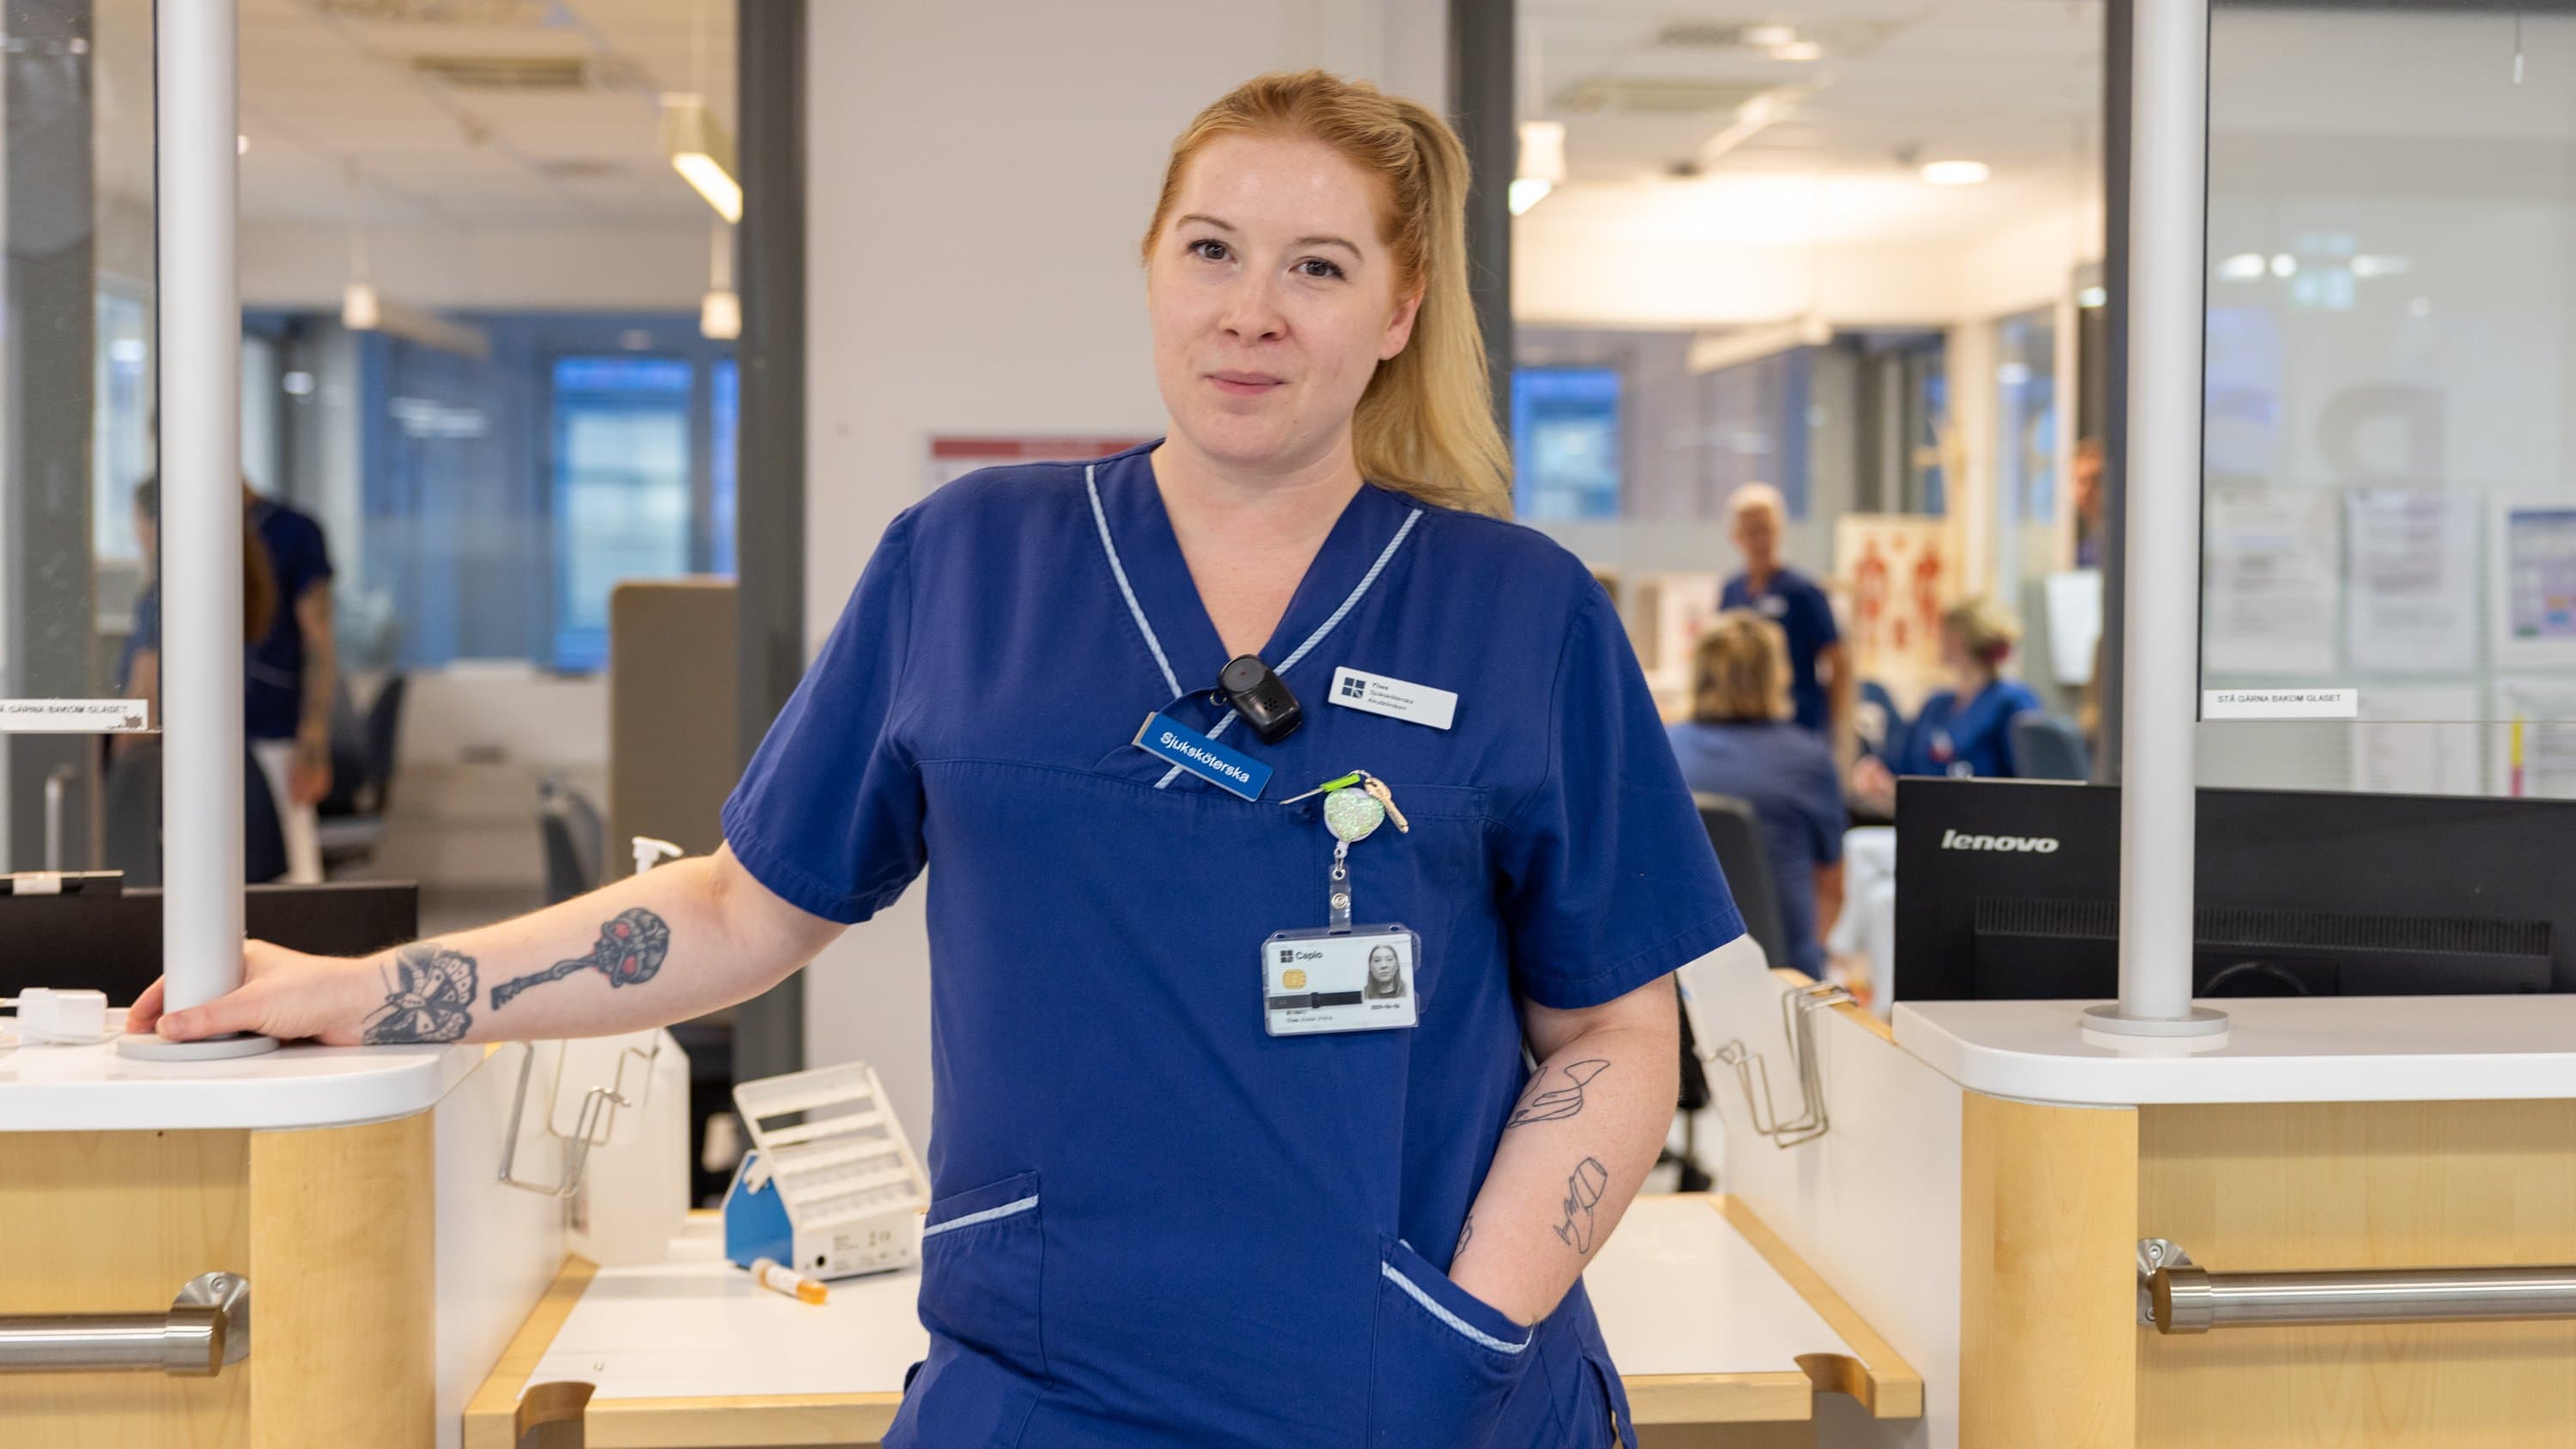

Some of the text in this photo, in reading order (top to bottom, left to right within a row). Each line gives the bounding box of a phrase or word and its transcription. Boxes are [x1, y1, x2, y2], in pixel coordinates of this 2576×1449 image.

[2217, 692, 2341, 703] STÅ GÄRNA BAKOM GLASET
[1160, 731, 1250, 783] Sjuksköterska
[1941, 829, 2059, 853] lenovo
